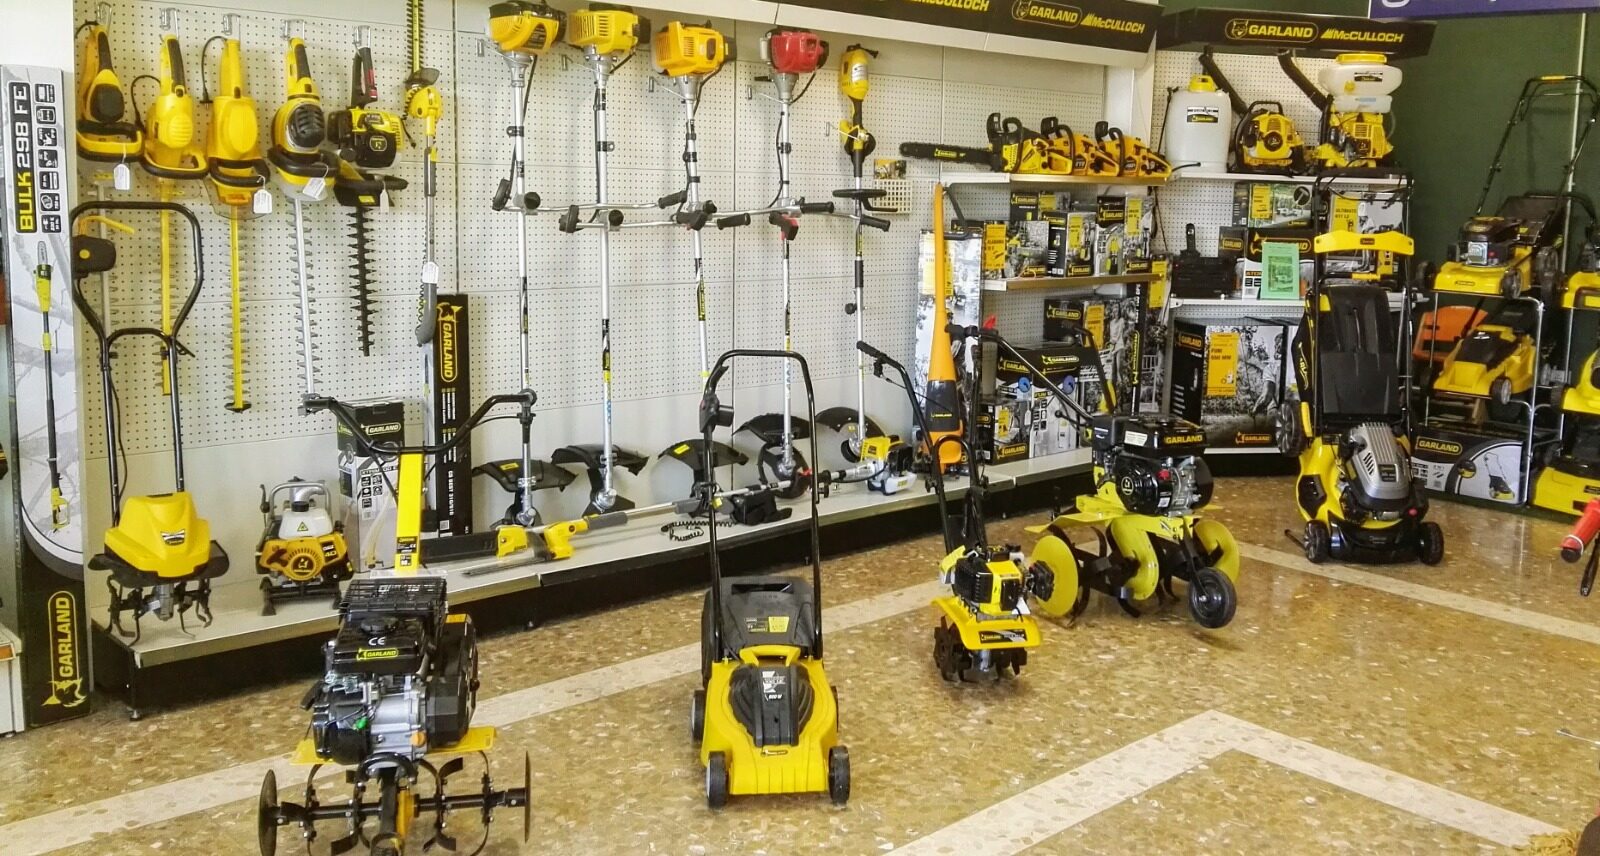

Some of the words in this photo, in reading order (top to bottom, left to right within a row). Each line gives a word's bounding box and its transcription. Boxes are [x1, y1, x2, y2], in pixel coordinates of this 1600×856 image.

[1029, 5, 1078, 23] GARLAND
[1091, 15, 1146, 34] McCULLOCH
[1248, 24, 1313, 38] GARLAND
[1332, 30, 1405, 43] McCULLOCH
[13, 86, 28, 114] FE
[15, 122, 31, 168] 298
[16, 170, 34, 230] BULK
[440, 321, 454, 380] GARLAND
[1006, 363, 1030, 372] GARLAN
[369, 424, 399, 433] GARLAND
[1165, 434, 1203, 444] GARLAND
[1418, 440, 1460, 453] GARLAND
[56, 597, 73, 677] GARLAND
[368, 636, 386, 646] CE
